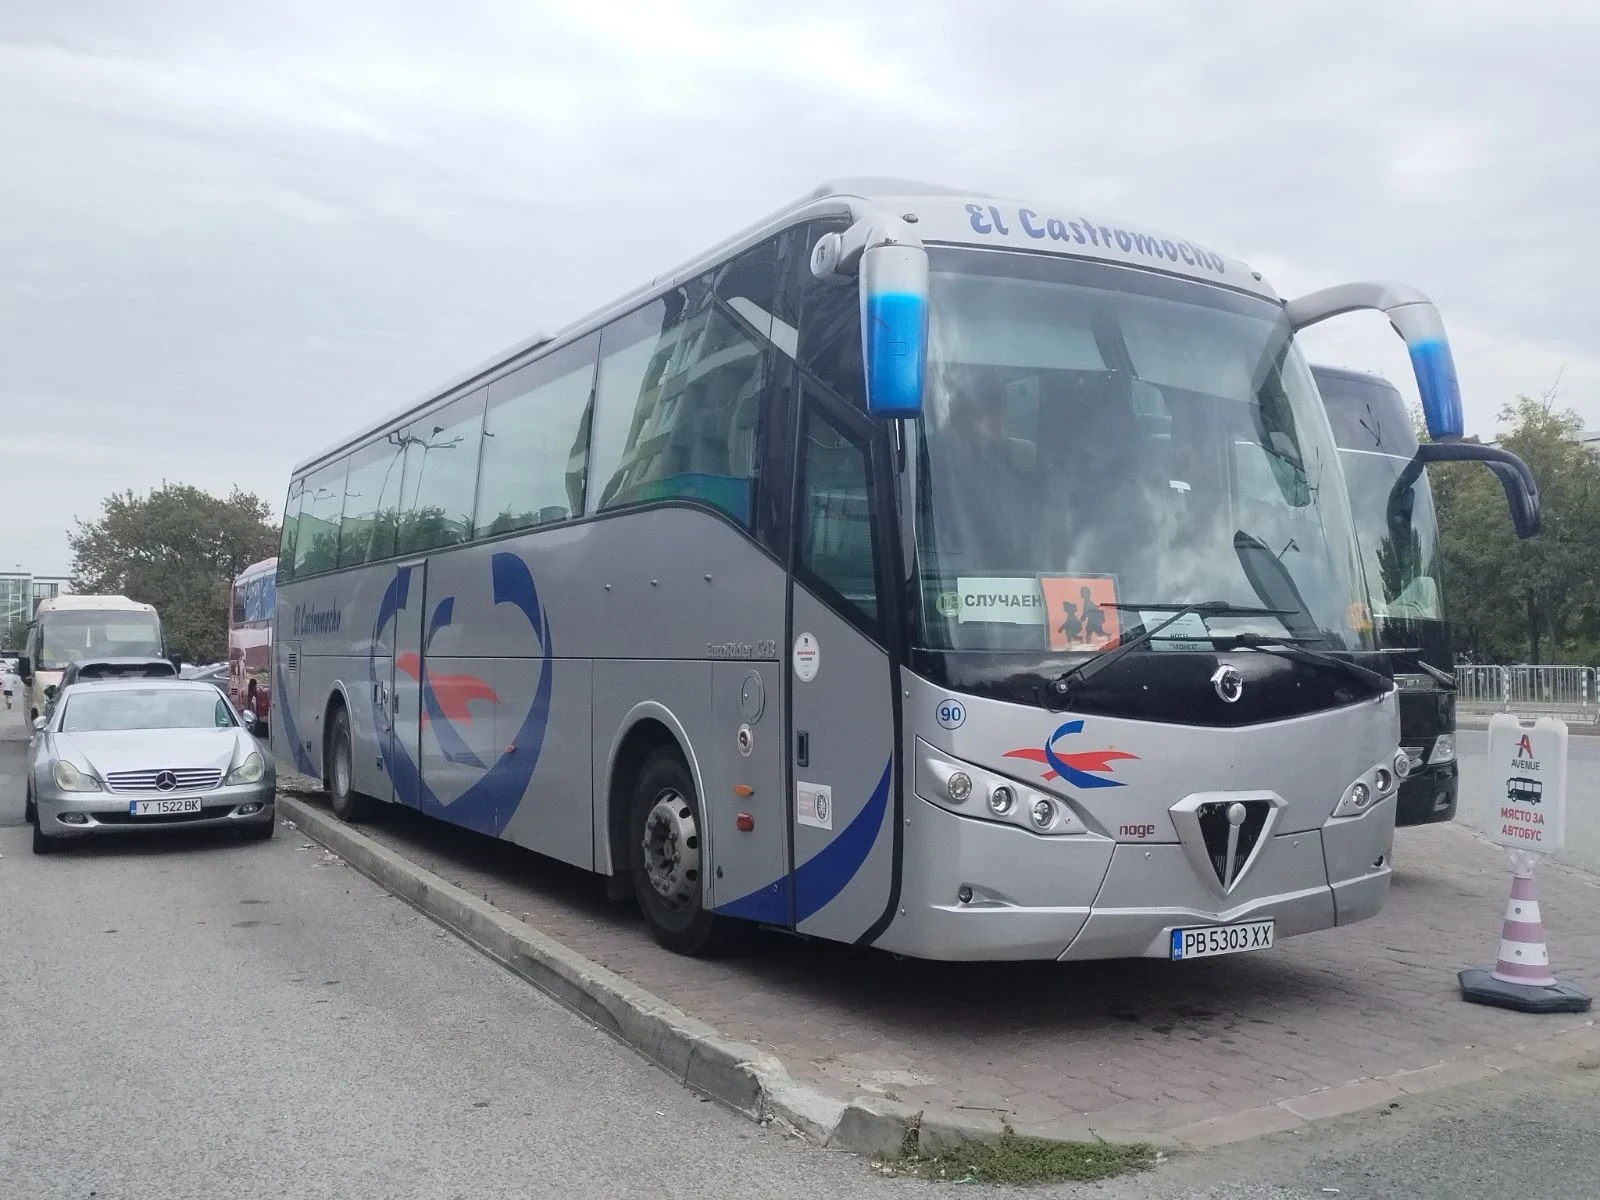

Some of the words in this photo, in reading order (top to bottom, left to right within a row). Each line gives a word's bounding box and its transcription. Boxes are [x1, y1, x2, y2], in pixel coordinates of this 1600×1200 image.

[964, 202, 1009, 236] El
[1018, 207, 1226, 275] Castromocho
[964, 594, 1043, 607] СЛУЧАЕН
[705, 641, 753, 659] EuroRider
[941, 707, 961, 722] 90
[1510, 759, 1541, 771] AVENUE
[1500, 807, 1532, 823] МЯСТО
[1532, 813, 1545, 826] ЗА
[1119, 824, 1155, 838] noge
[1501, 824, 1542, 842] АВТОБУС
